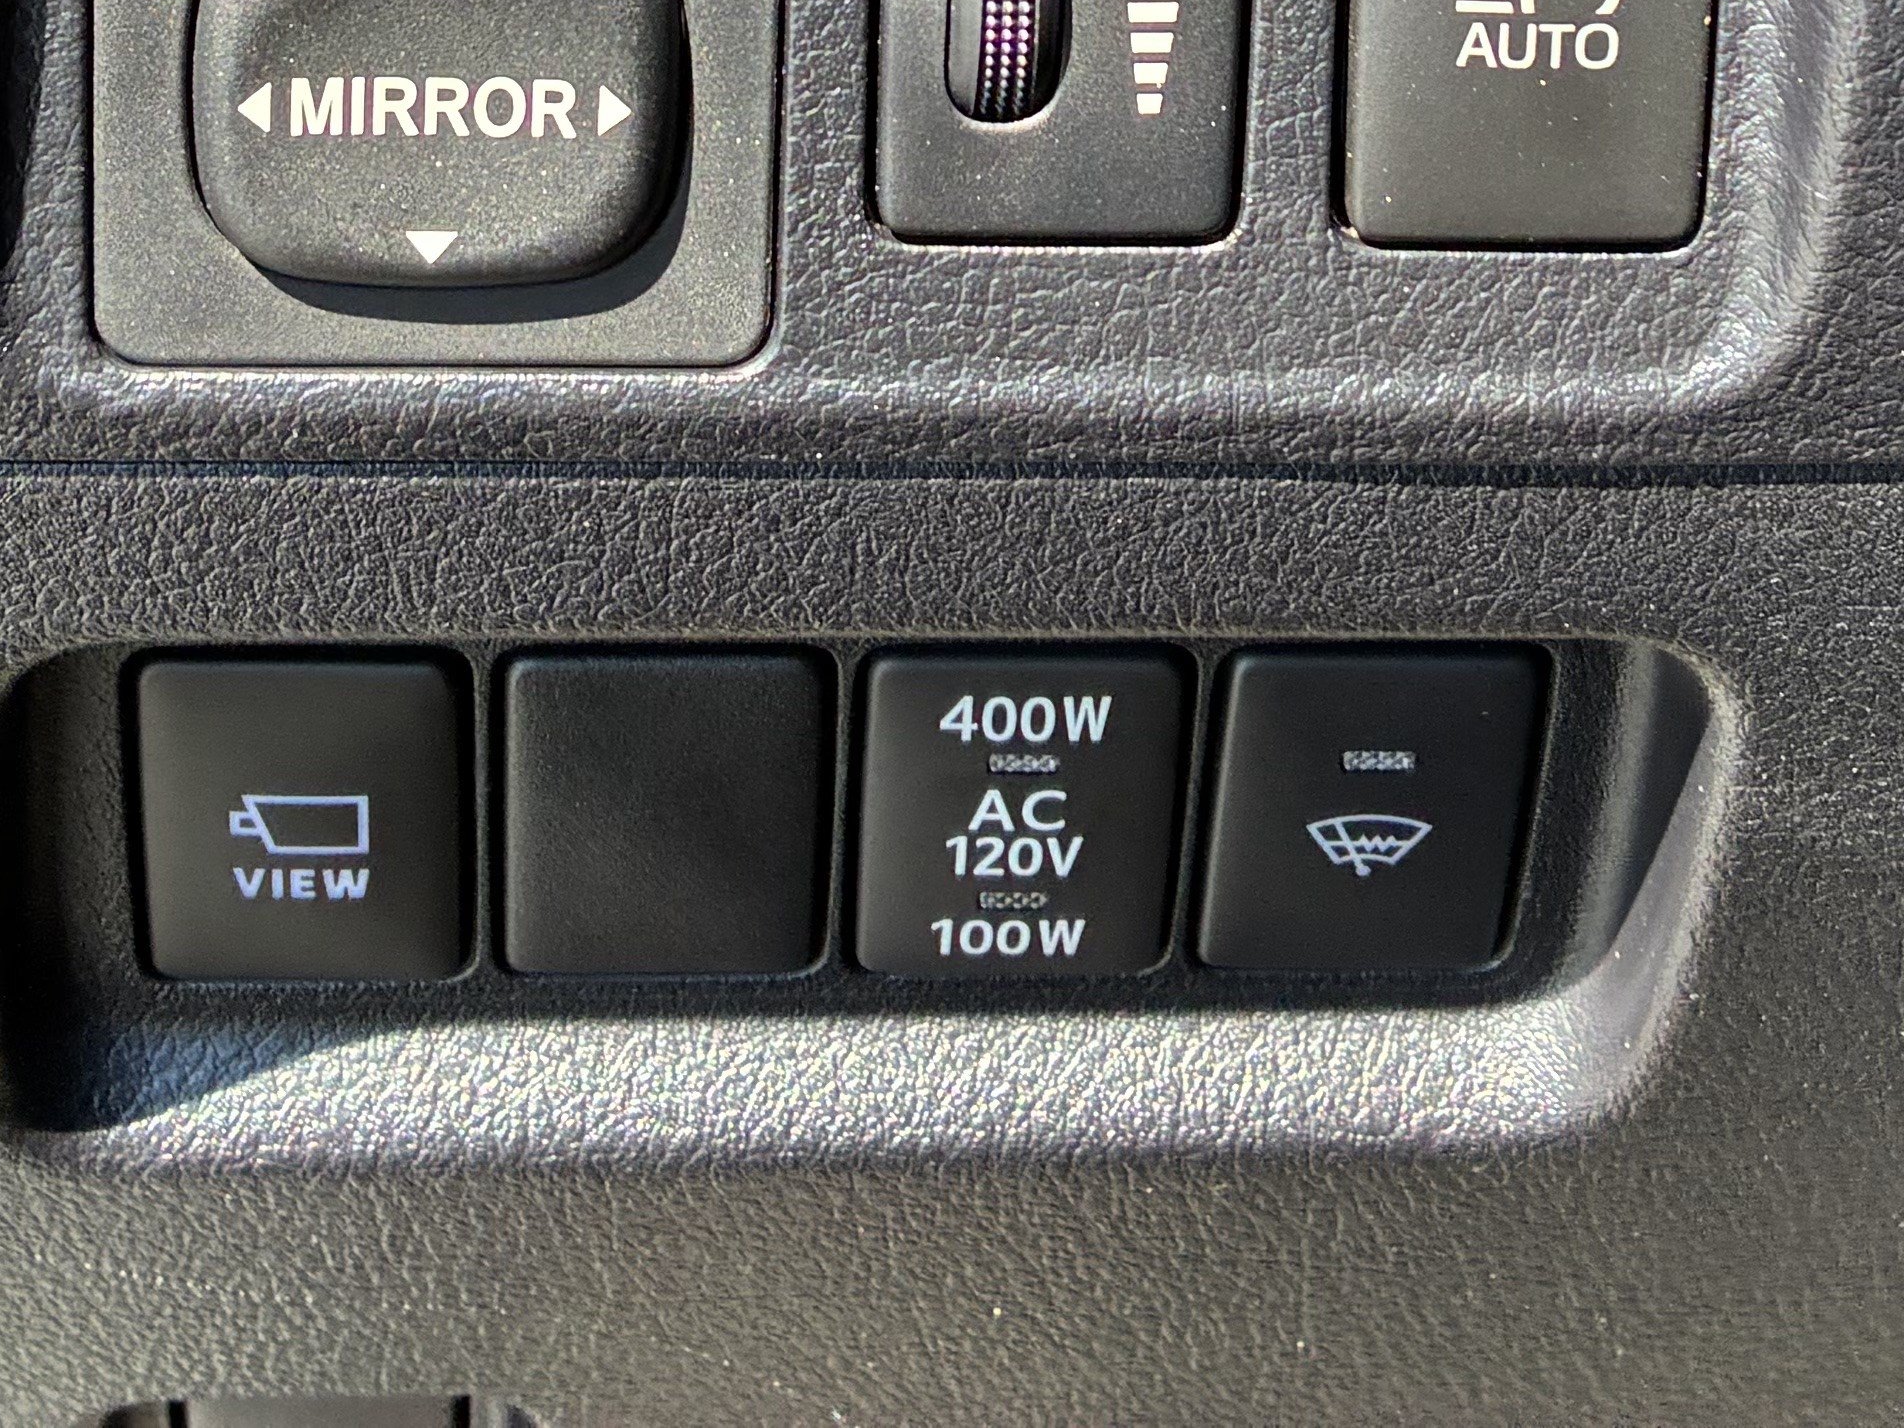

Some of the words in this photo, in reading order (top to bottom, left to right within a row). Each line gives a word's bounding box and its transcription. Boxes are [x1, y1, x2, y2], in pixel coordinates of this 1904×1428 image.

[1455, 22, 1620, 70] AUTO
[289, 76, 577, 139] MIRROR
[939, 695, 1113, 743] 400W
[967, 788, 1068, 832] AC
[946, 835, 1084, 878] 120V
[232, 867, 370, 900] VIEW
[930, 918, 1087, 956] 100W
